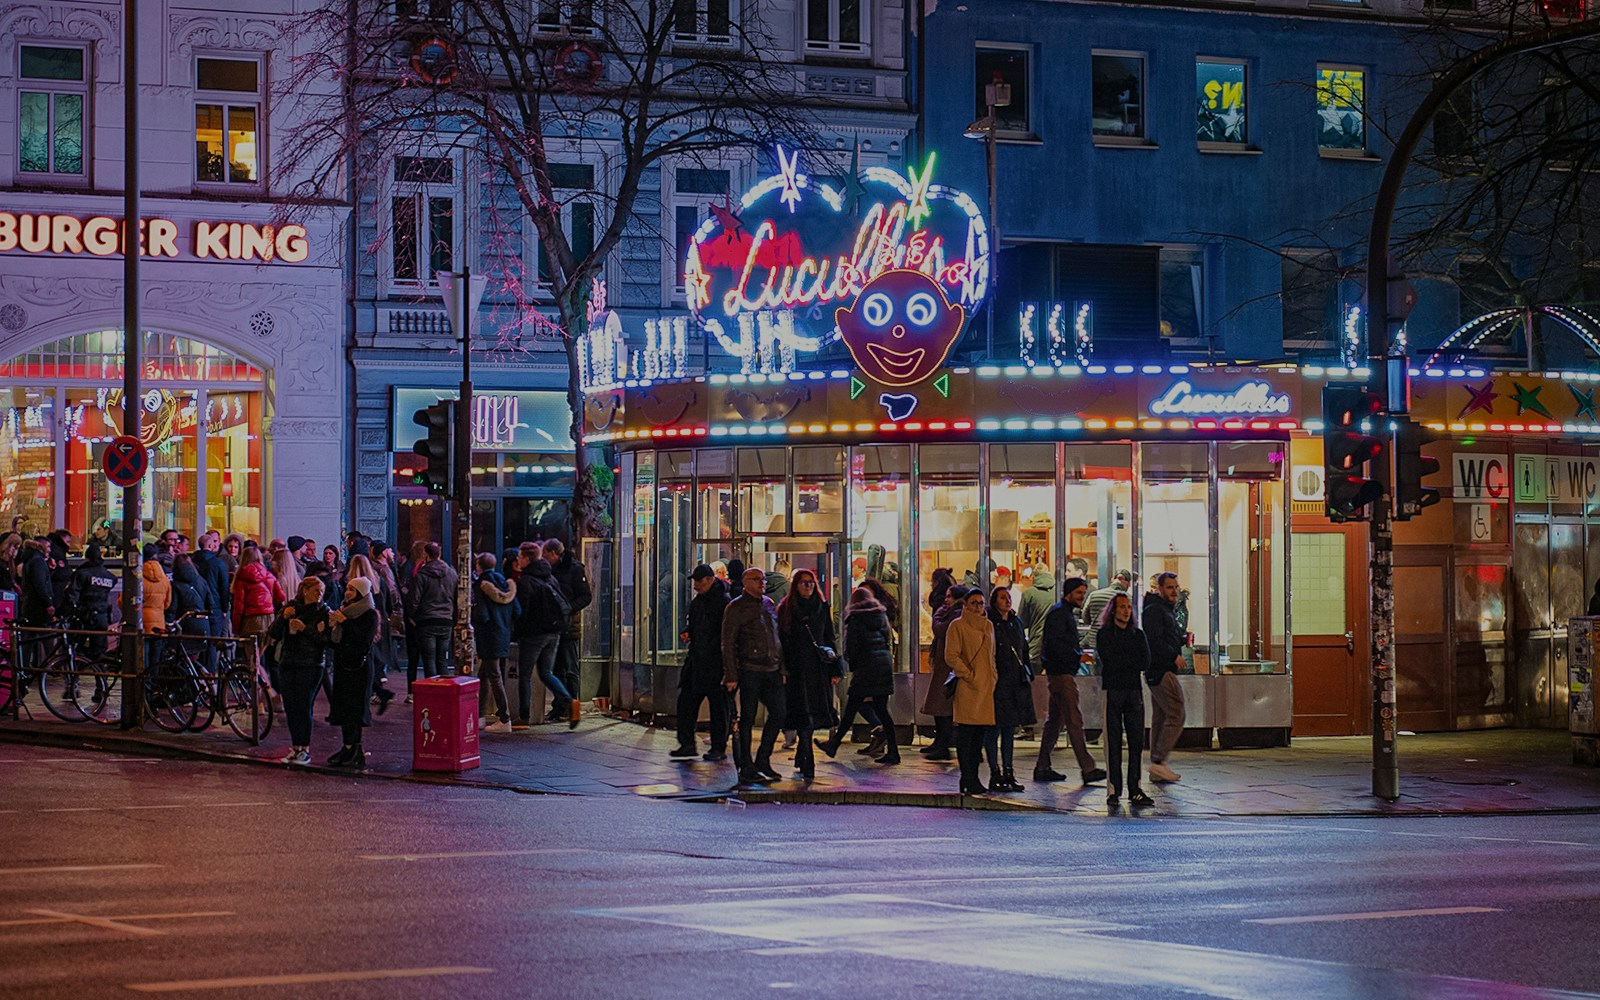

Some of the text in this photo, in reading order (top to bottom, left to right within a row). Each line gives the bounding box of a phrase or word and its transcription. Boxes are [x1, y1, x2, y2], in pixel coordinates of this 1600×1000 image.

[197, 221, 310, 263] KING
[1151, 380, 1290, 415] Lucullus
[1458, 458, 1504, 499] WC
[1567, 461, 1597, 499] WC
